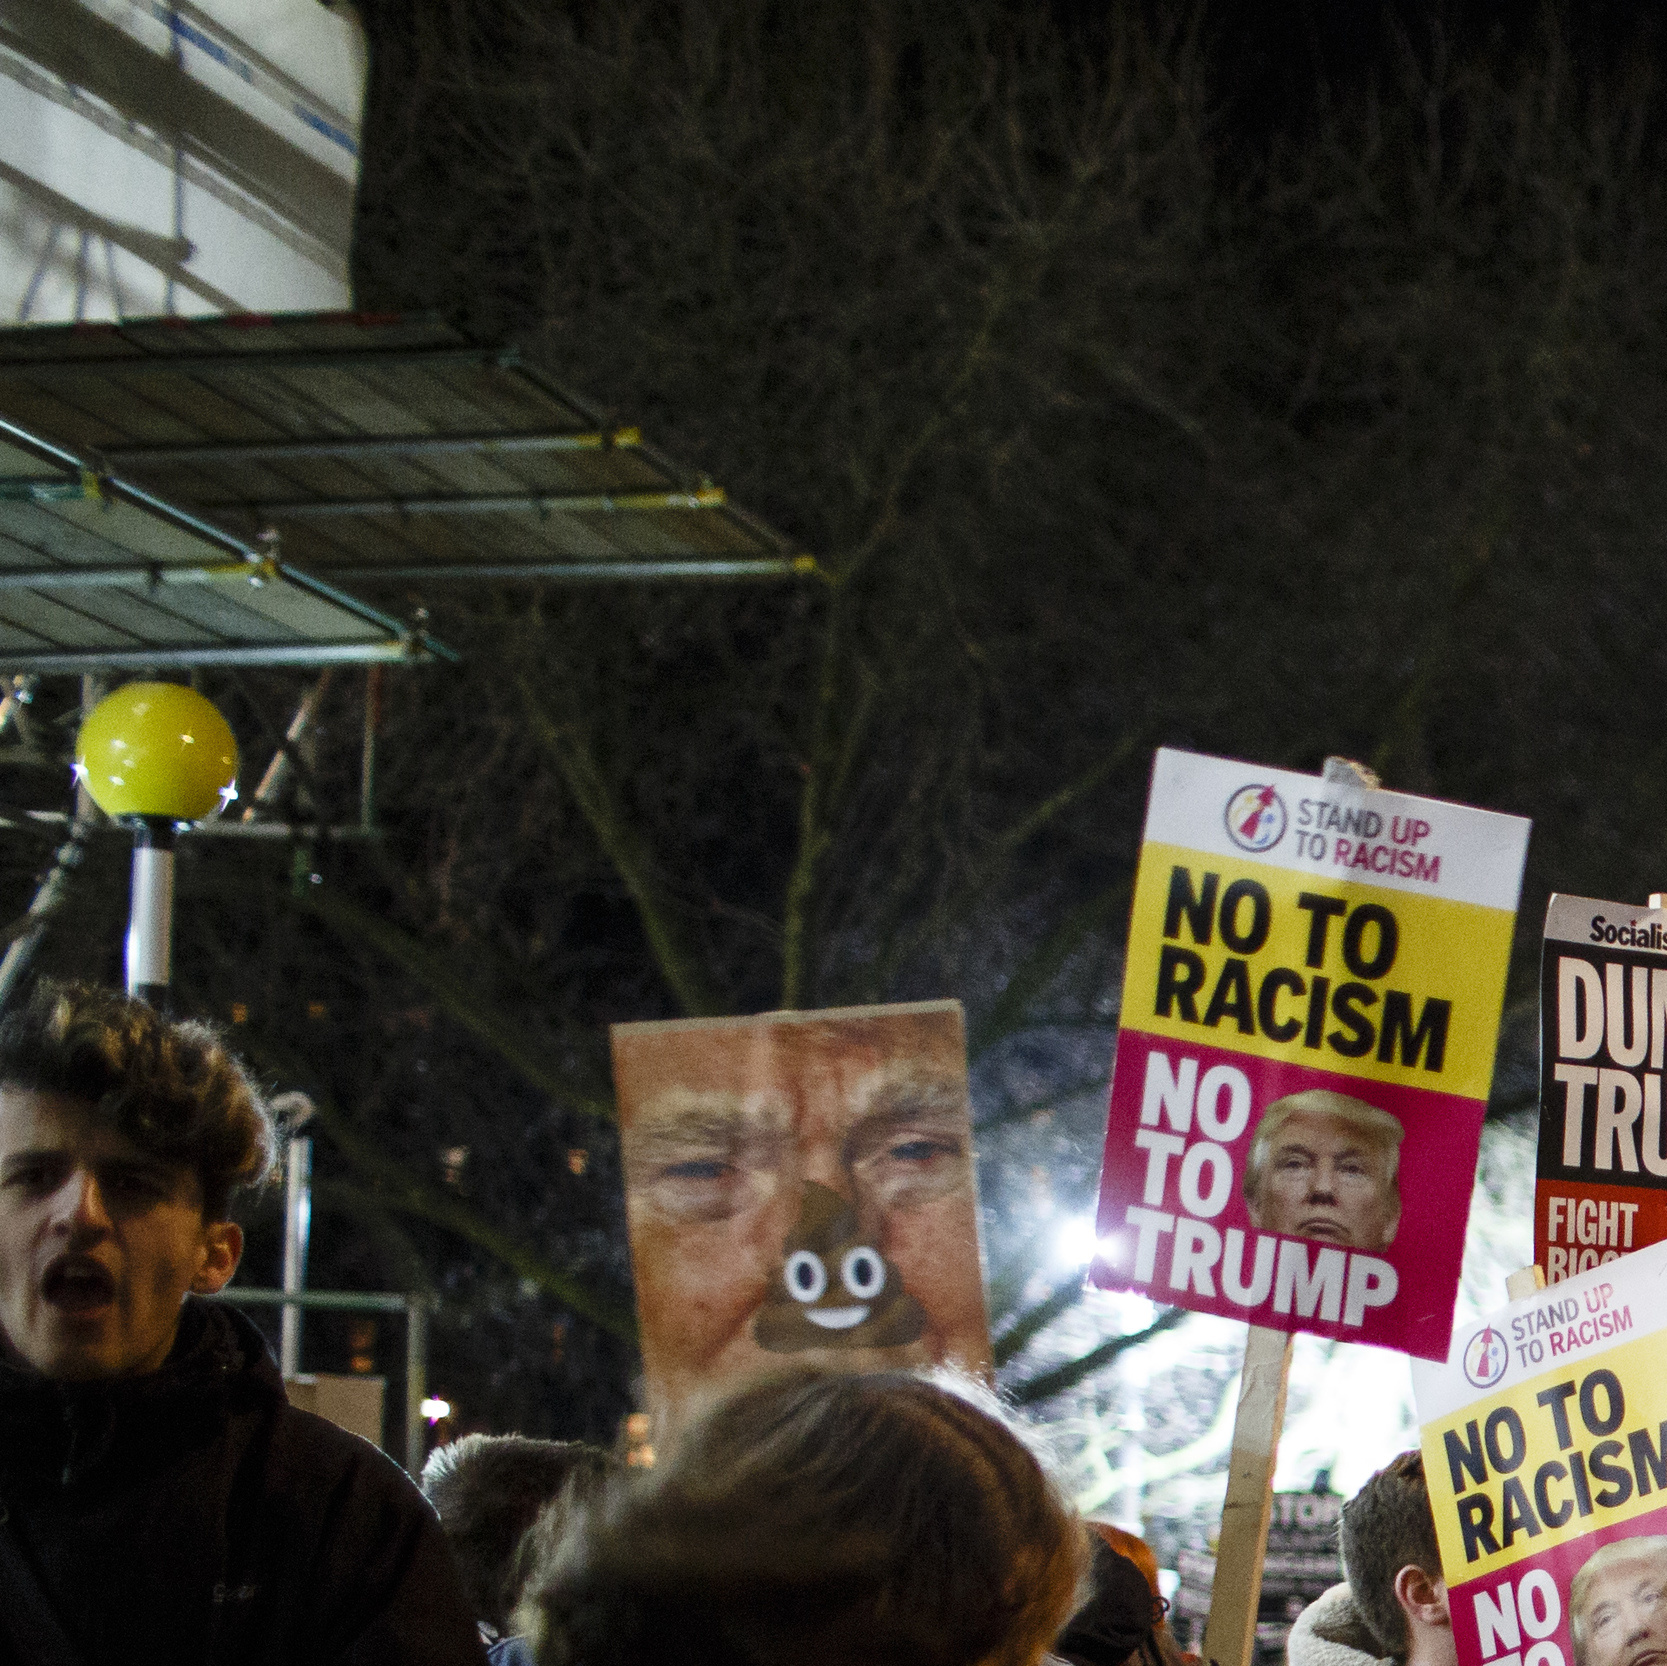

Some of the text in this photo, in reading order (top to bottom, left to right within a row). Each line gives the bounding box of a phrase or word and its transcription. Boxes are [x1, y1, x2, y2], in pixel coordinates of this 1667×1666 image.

[1295, 831, 1441, 883] TO RACISM
[1297, 799, 1430, 845] STAND UP
[1162, 866, 1399, 979] NO TO
[1154, 945, 1452, 1072] RACISM
[1141, 1050, 1252, 1142] NO
[1135, 1129, 1233, 1218] TO
[1126, 1205, 1398, 1328] TRUMP
[1548, 1197, 1638, 1248] FIGHT
[1512, 1282, 1615, 1342] STAND UP
[1516, 1305, 1634, 1368] TO RACISM
[1443, 1368, 1626, 1495] NO TO
[1473, 1568, 1561, 1659] NO
